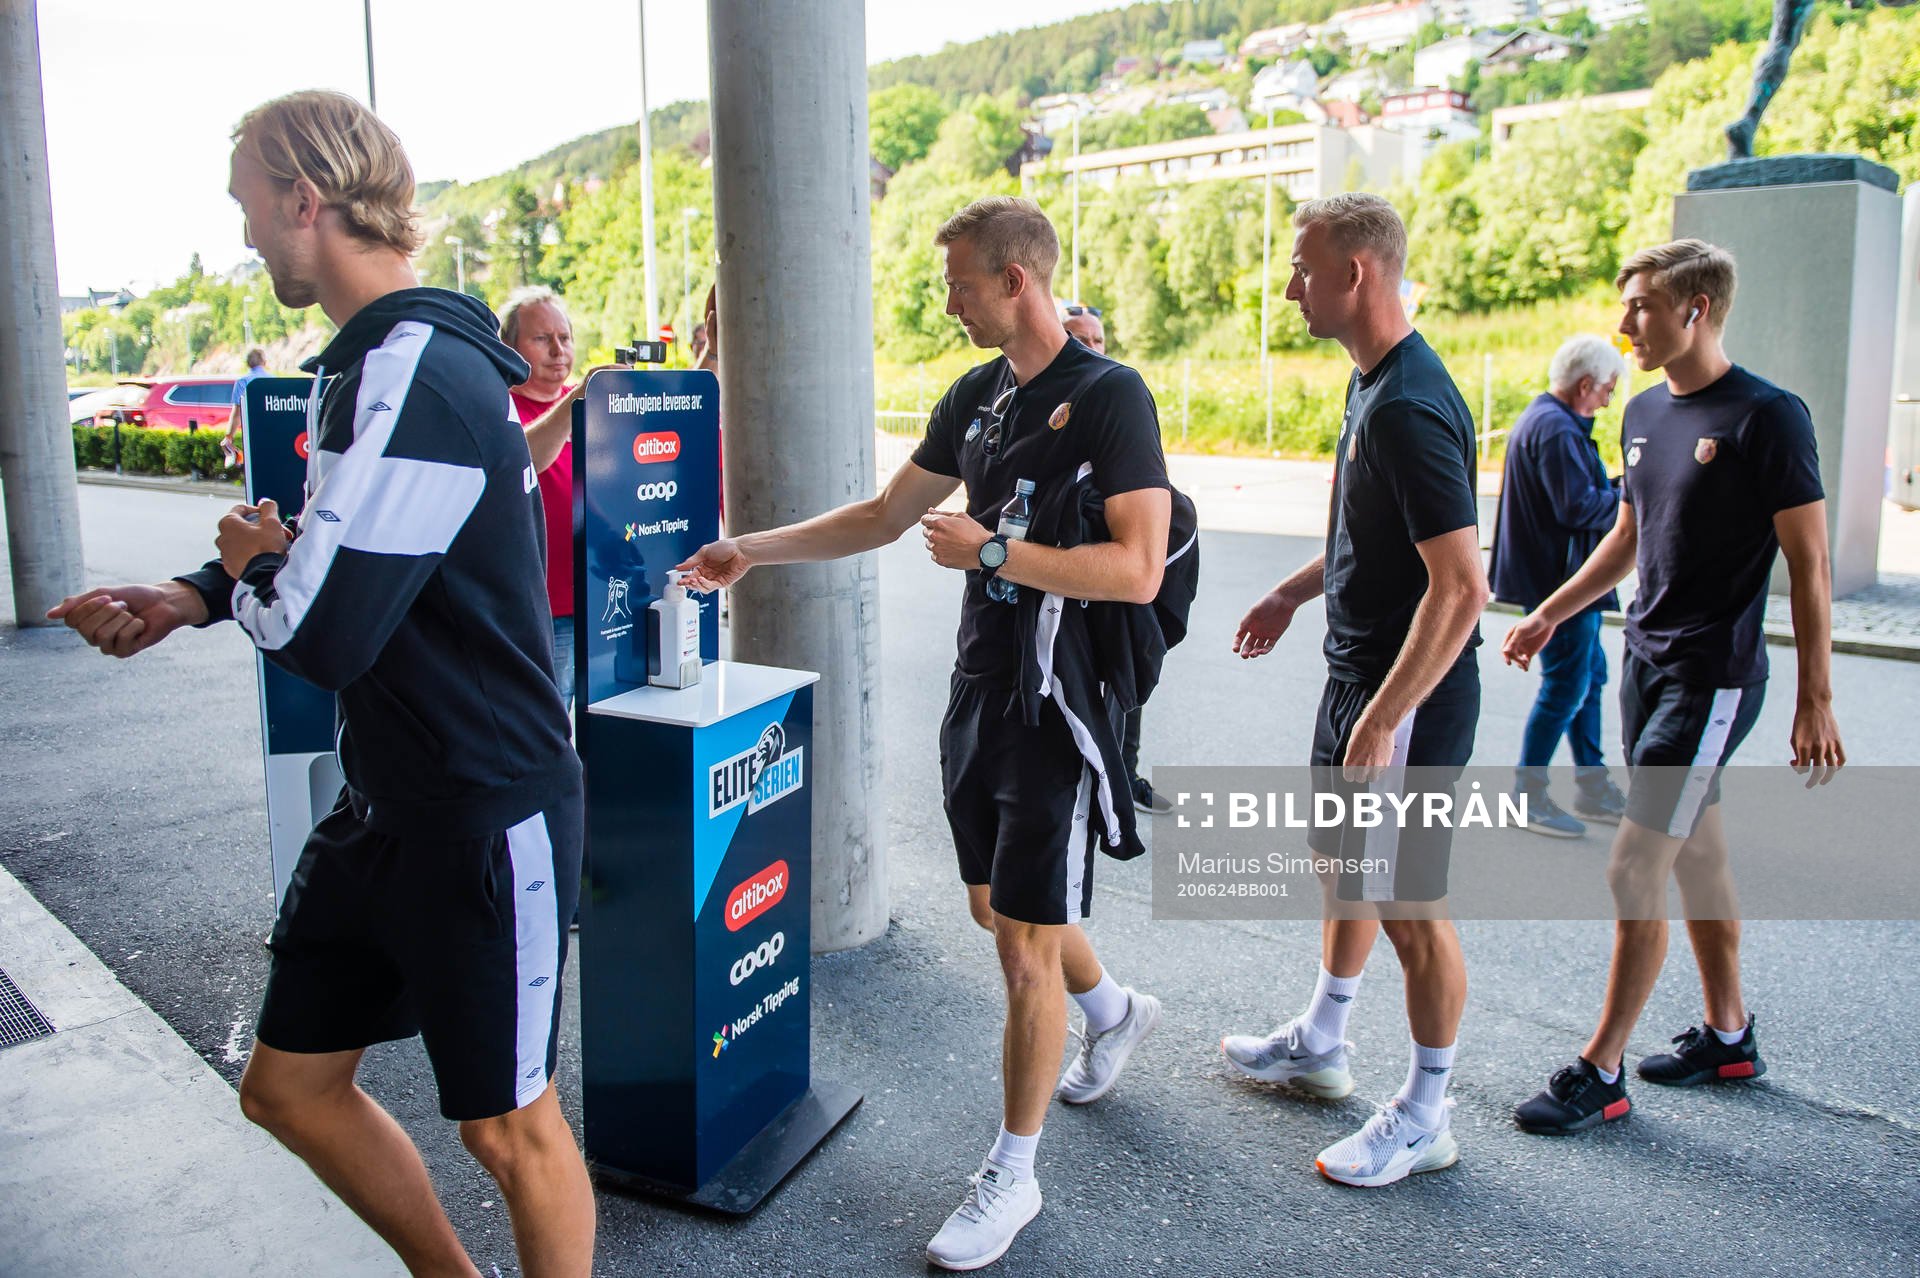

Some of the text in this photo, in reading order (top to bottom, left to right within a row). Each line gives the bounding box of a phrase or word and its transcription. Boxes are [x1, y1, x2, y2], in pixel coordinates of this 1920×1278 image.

[608, 393, 662, 414] Håndhygiene
[662, 392, 691, 411] leveres
[638, 438, 676, 456] altibox
[637, 480, 678, 501] coop
[638, 518, 689, 536] Norsk Tipping
[713, 753, 757, 811] ELITE
[754, 753, 800, 805] SERIEN
[731, 872, 783, 920] altibox
[729, 931, 785, 986] coop
[731, 976, 799, 1040] Norsk Tipping
